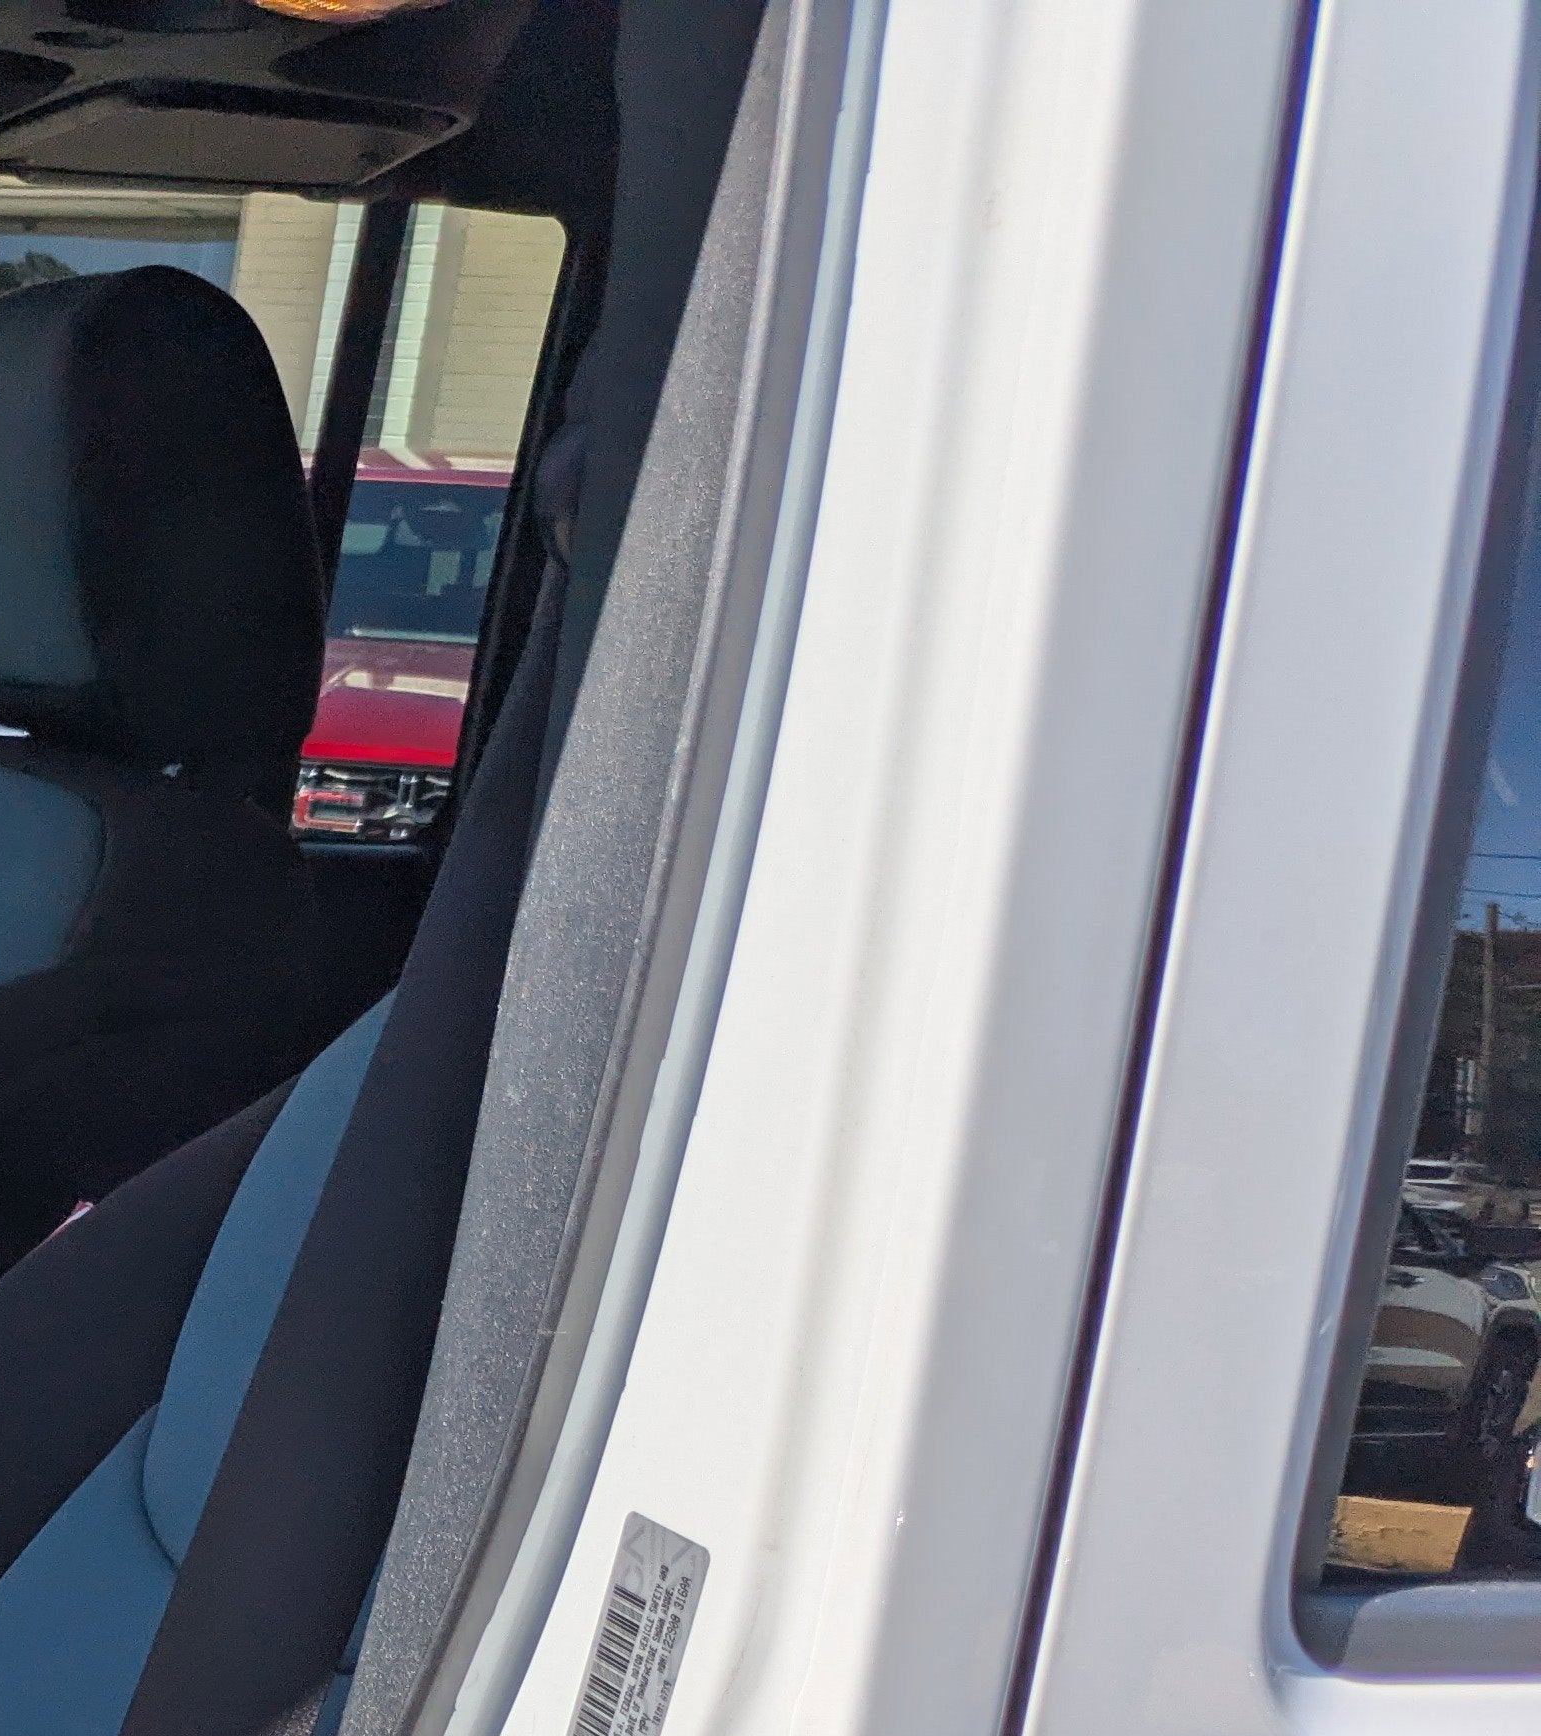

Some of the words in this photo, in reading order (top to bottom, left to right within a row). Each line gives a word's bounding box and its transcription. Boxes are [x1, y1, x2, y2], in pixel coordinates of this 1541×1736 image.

[619, 1682, 635, 1716] FEDERAL
[638, 1616, 654, 1651] VEHICLE
[648, 1582, 664, 1614] SAFETY
[624, 1714, 637, 1736] DATE
[631, 1700, 641, 1713] OF
[652, 1616, 665, 1643] SHOWN
[637, 1711, 651, 1735] MPV
